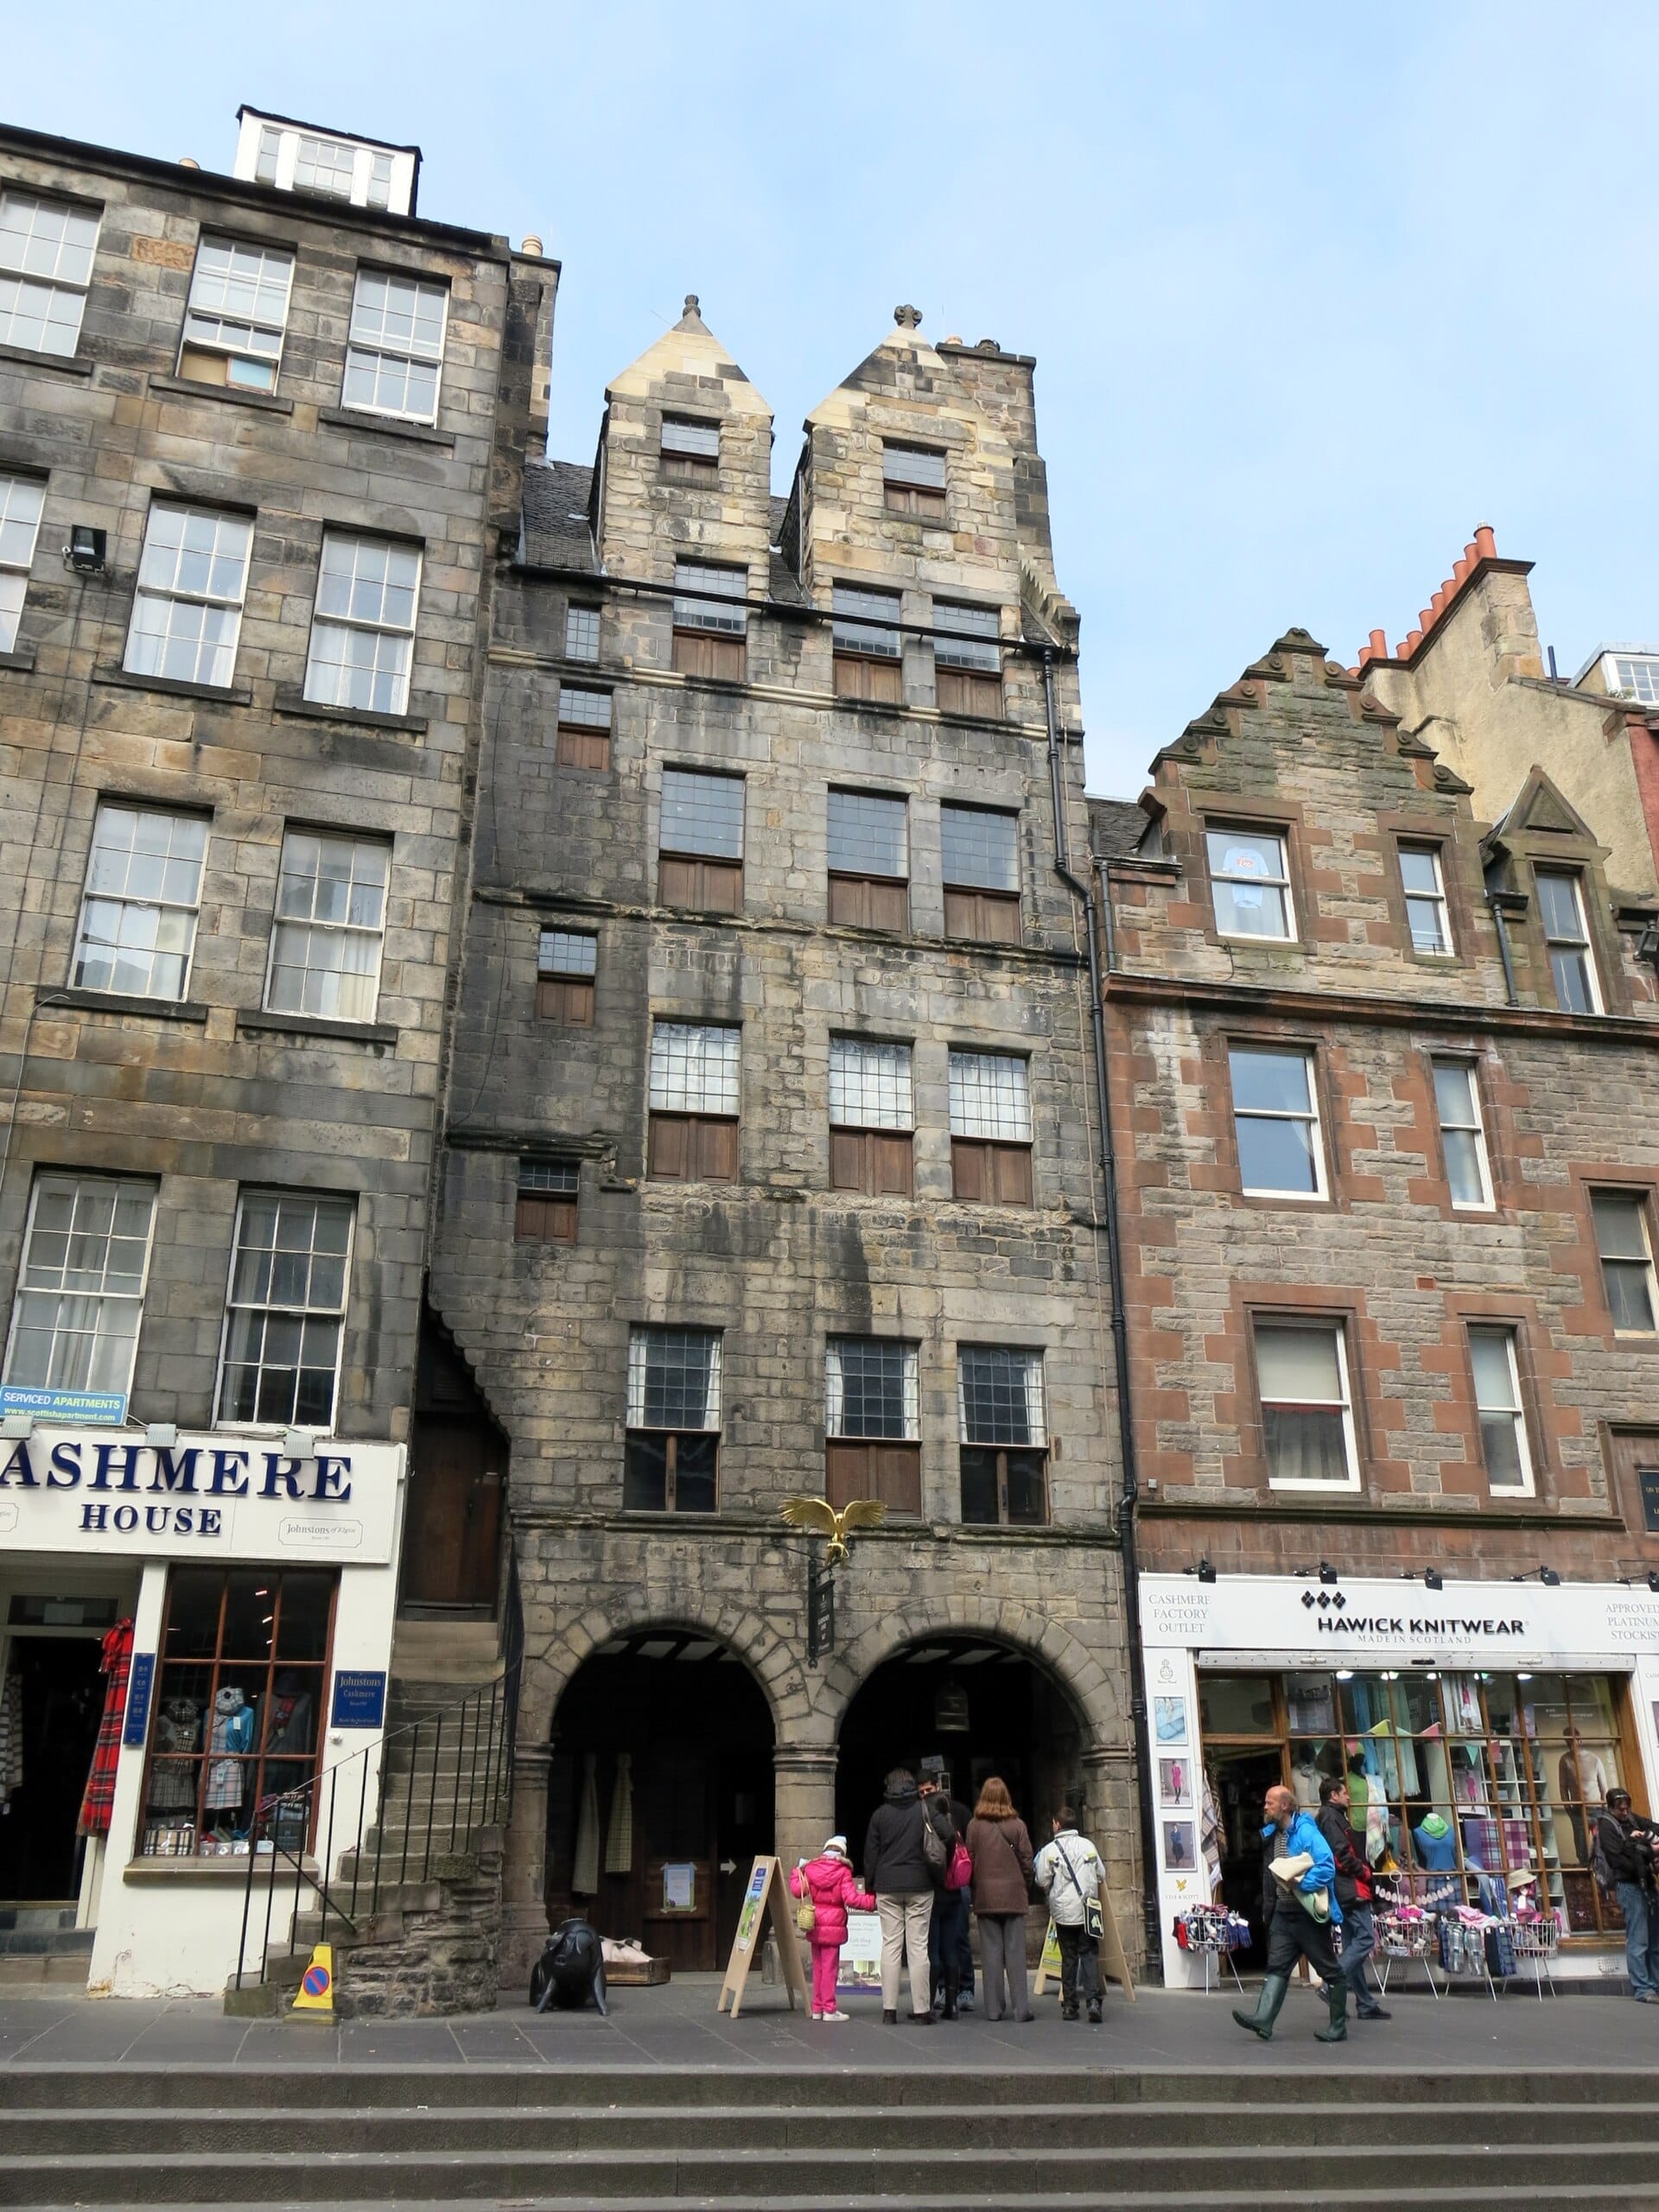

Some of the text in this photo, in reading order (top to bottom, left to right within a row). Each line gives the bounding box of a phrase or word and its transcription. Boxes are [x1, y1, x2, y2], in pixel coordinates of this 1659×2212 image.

[3, 1392, 120, 1409] SERVICED APARTMENTS
[4, 1408, 115, 1421] www.scottishapartment.com
[78, 1503, 221, 1534] HOUSE
[287, 1523, 330, 1535] Johnstons
[1148, 1593, 1211, 1605] CASHMERE
[1154, 1608, 1208, 1618] FACTORY
[1159, 1623, 1205, 1633] OUTLET
[1318, 1618, 1525, 1635] HAWICK KNITWEAR
[1357, 1635, 1390, 1643] MADE
[1409, 1636, 1471, 1645] SCOTLAND
[339, 1675, 382, 1688] Johnstons
